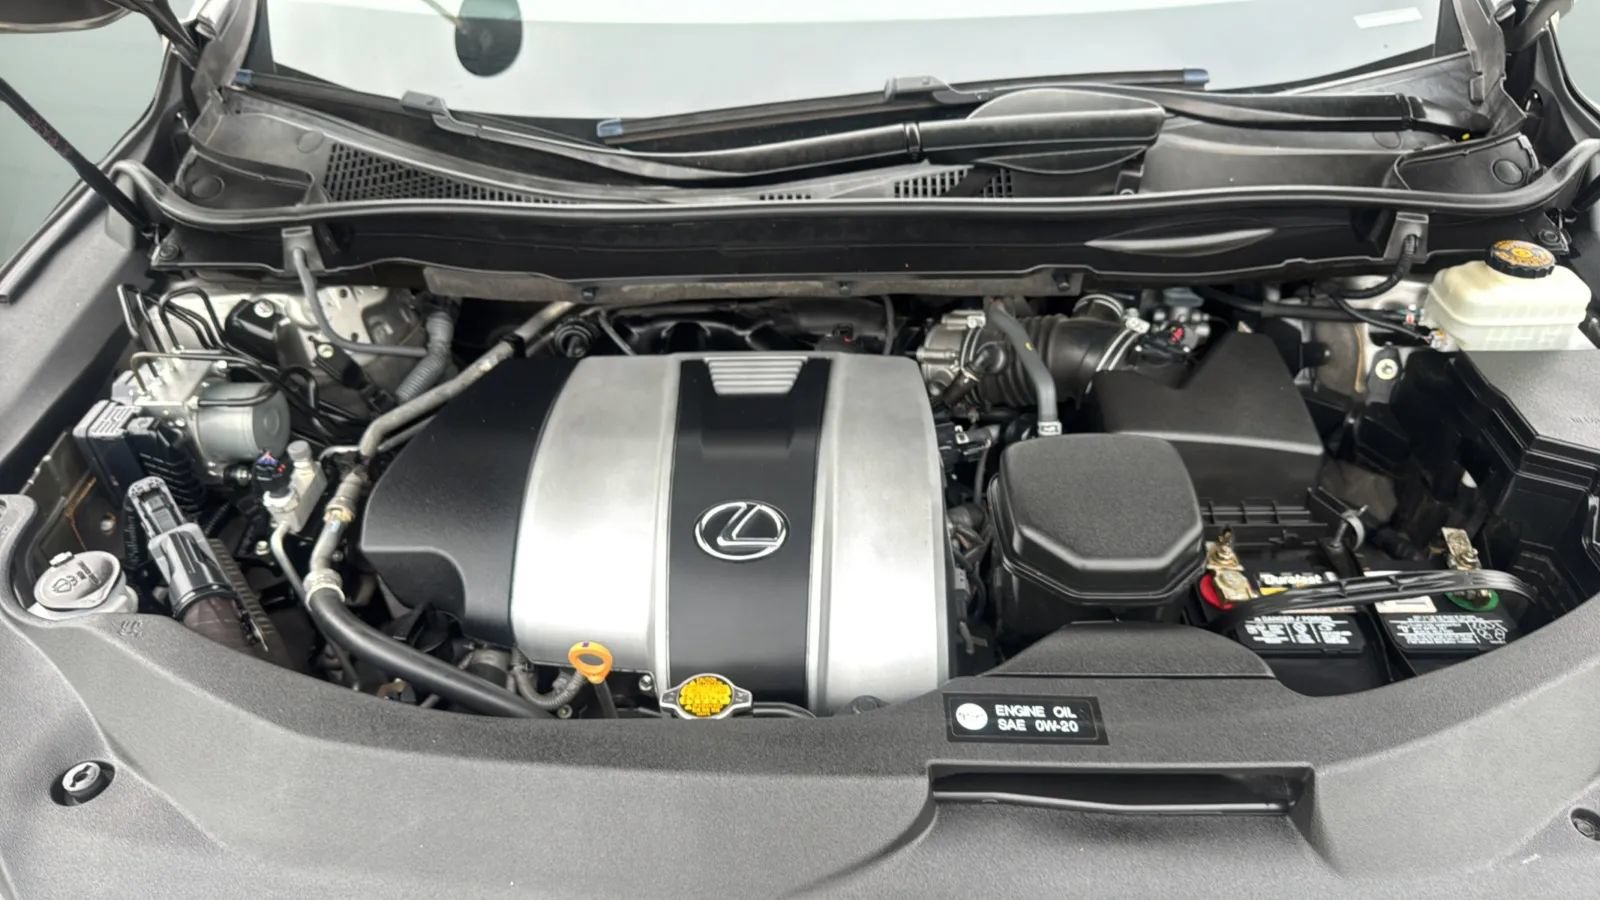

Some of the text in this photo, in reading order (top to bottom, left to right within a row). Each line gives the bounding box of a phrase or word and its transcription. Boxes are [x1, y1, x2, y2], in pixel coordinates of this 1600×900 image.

[995, 704, 1046, 718] ENGINE
[1053, 705, 1078, 718] OIL
[997, 718, 1079, 732] SAE 0W-20
